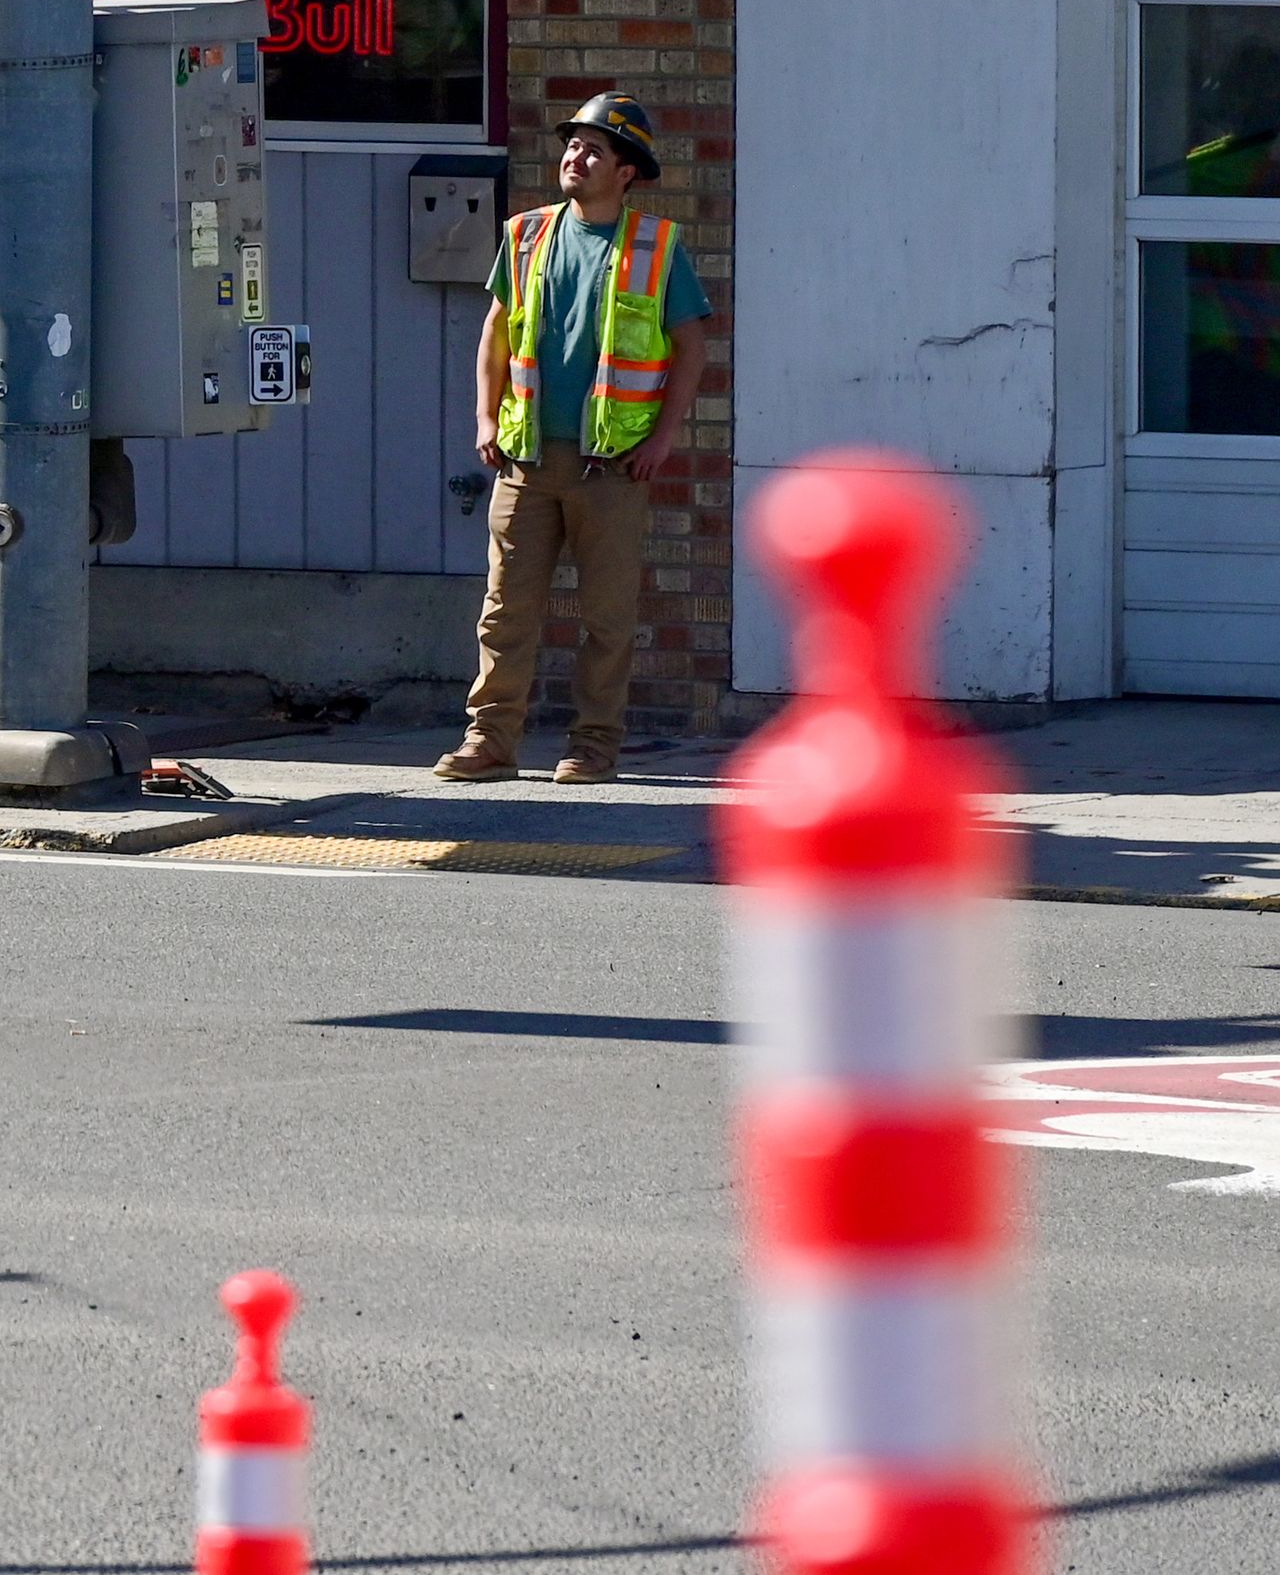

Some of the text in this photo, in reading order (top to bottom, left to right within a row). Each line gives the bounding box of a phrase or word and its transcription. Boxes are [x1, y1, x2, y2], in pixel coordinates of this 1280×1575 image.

[259, 333, 283, 342] PUSH
[254, 342, 289, 352] BUTTON
[262, 352, 281, 360] FOR
